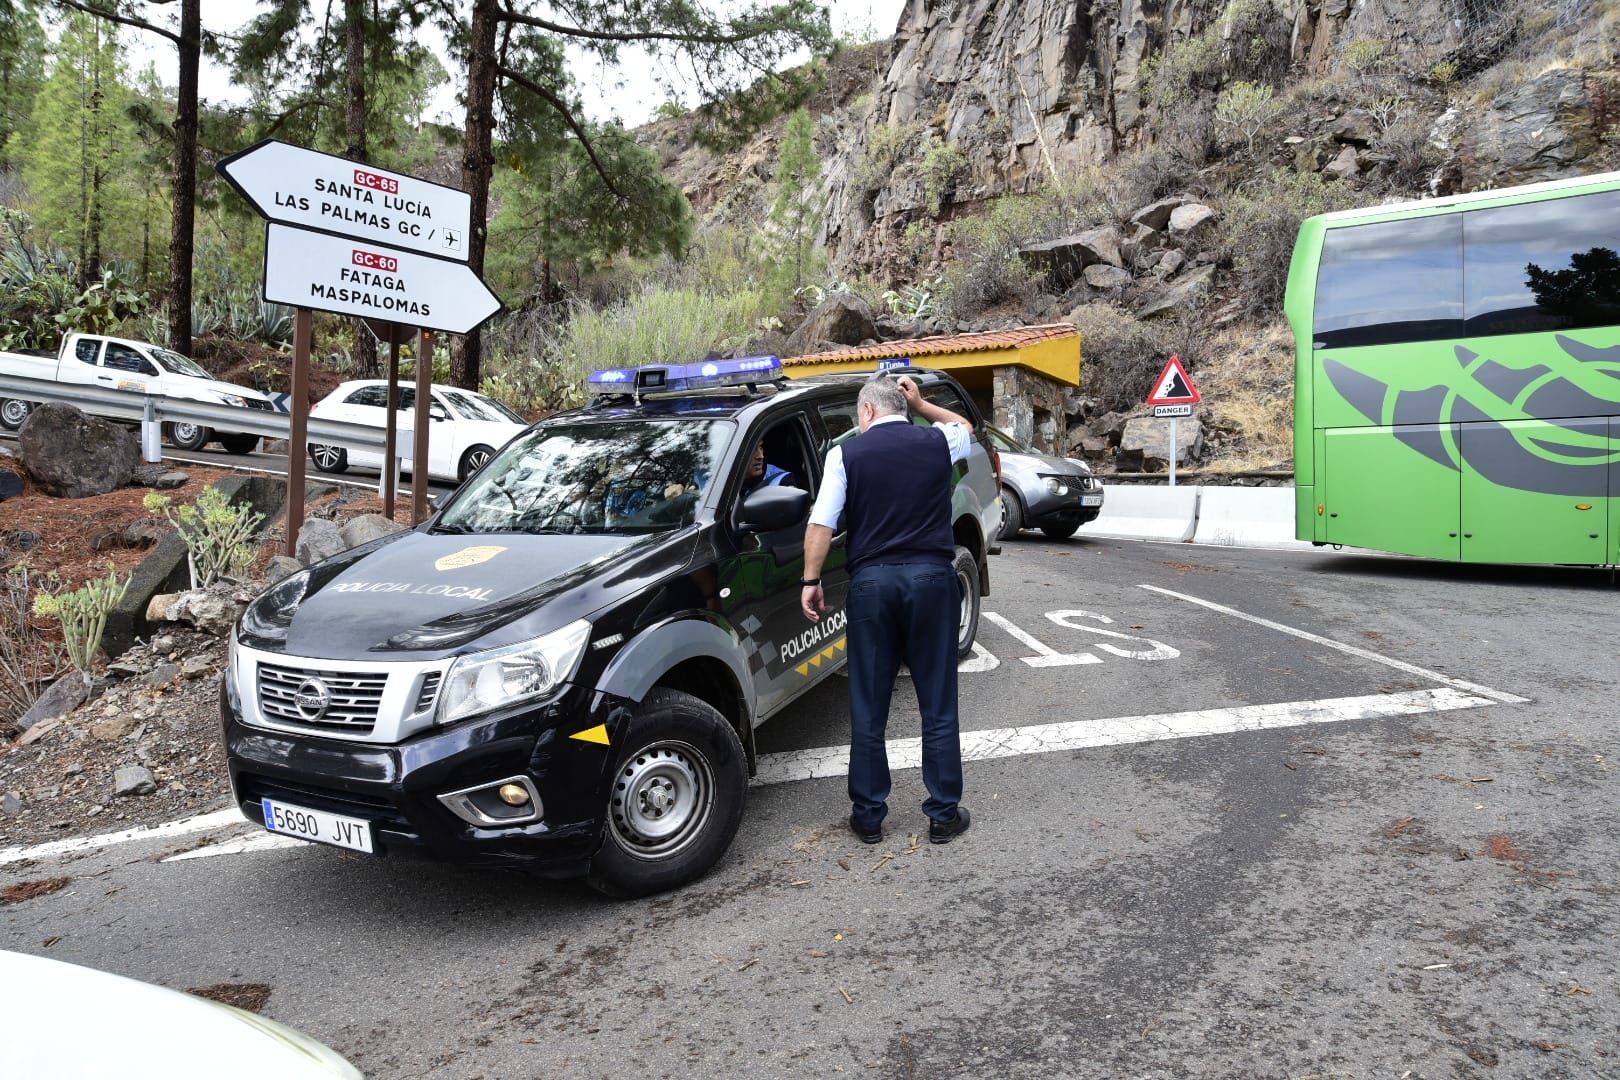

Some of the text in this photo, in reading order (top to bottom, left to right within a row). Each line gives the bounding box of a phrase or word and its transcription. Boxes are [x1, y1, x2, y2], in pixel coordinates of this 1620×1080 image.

[355, 171, 396, 191] GC-65
[315, 178, 431, 218] SANTA LUCÍA
[275, 192, 310, 211] LAS
[321, 202, 390, 230] PALMAS
[398, 221, 421, 240] GC
[354, 252, 395, 271] GC-60
[341, 268, 405, 292] FATAGA
[311, 283, 430, 316] MASPALOMAS
[327, 582, 493, 601] POLICIA LOCAL
[781, 607, 847, 664] POLICIA LOCA
[273, 806, 364, 847] 5690 JVT
